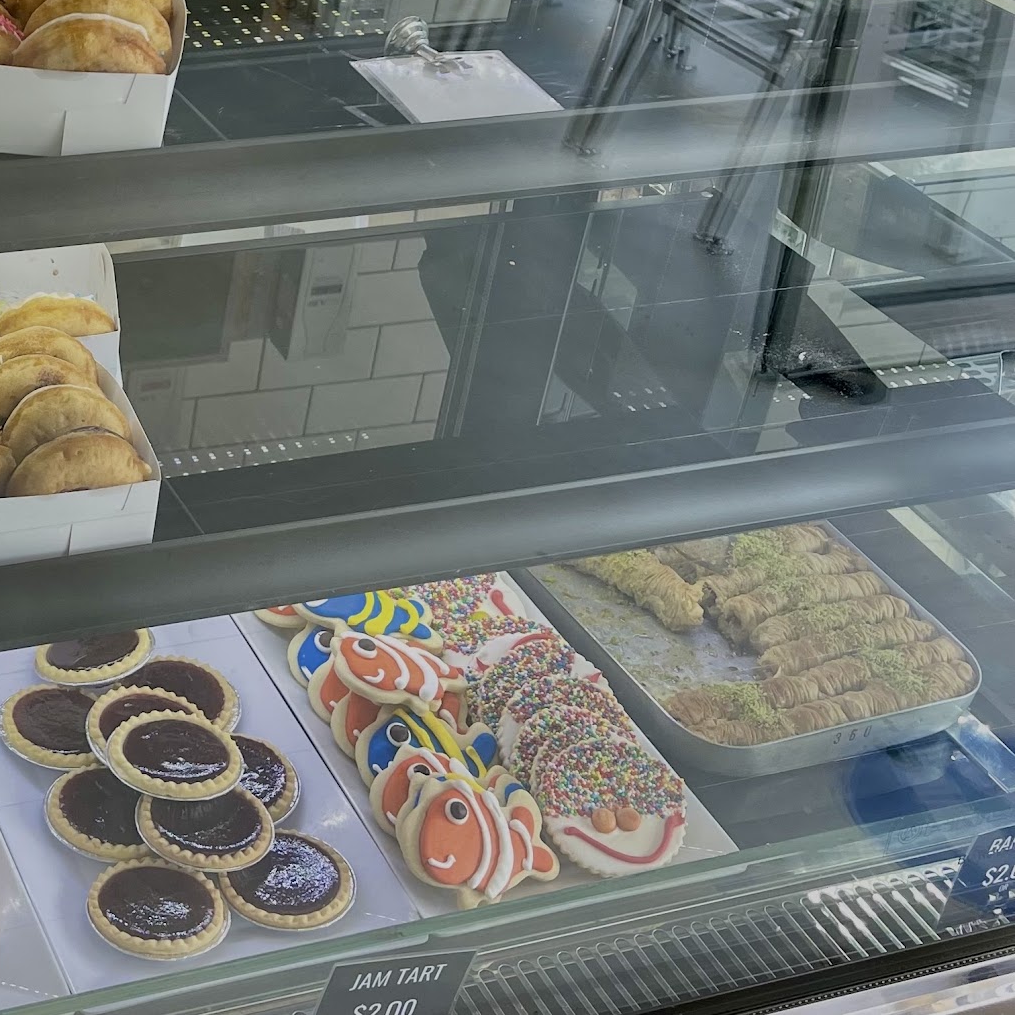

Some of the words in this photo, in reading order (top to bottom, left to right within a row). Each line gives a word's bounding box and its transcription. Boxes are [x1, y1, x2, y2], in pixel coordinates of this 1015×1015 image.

[348, 969, 393, 992] JAM
[396, 963, 449, 985] TART
[353, 998, 418, 1015] $200
